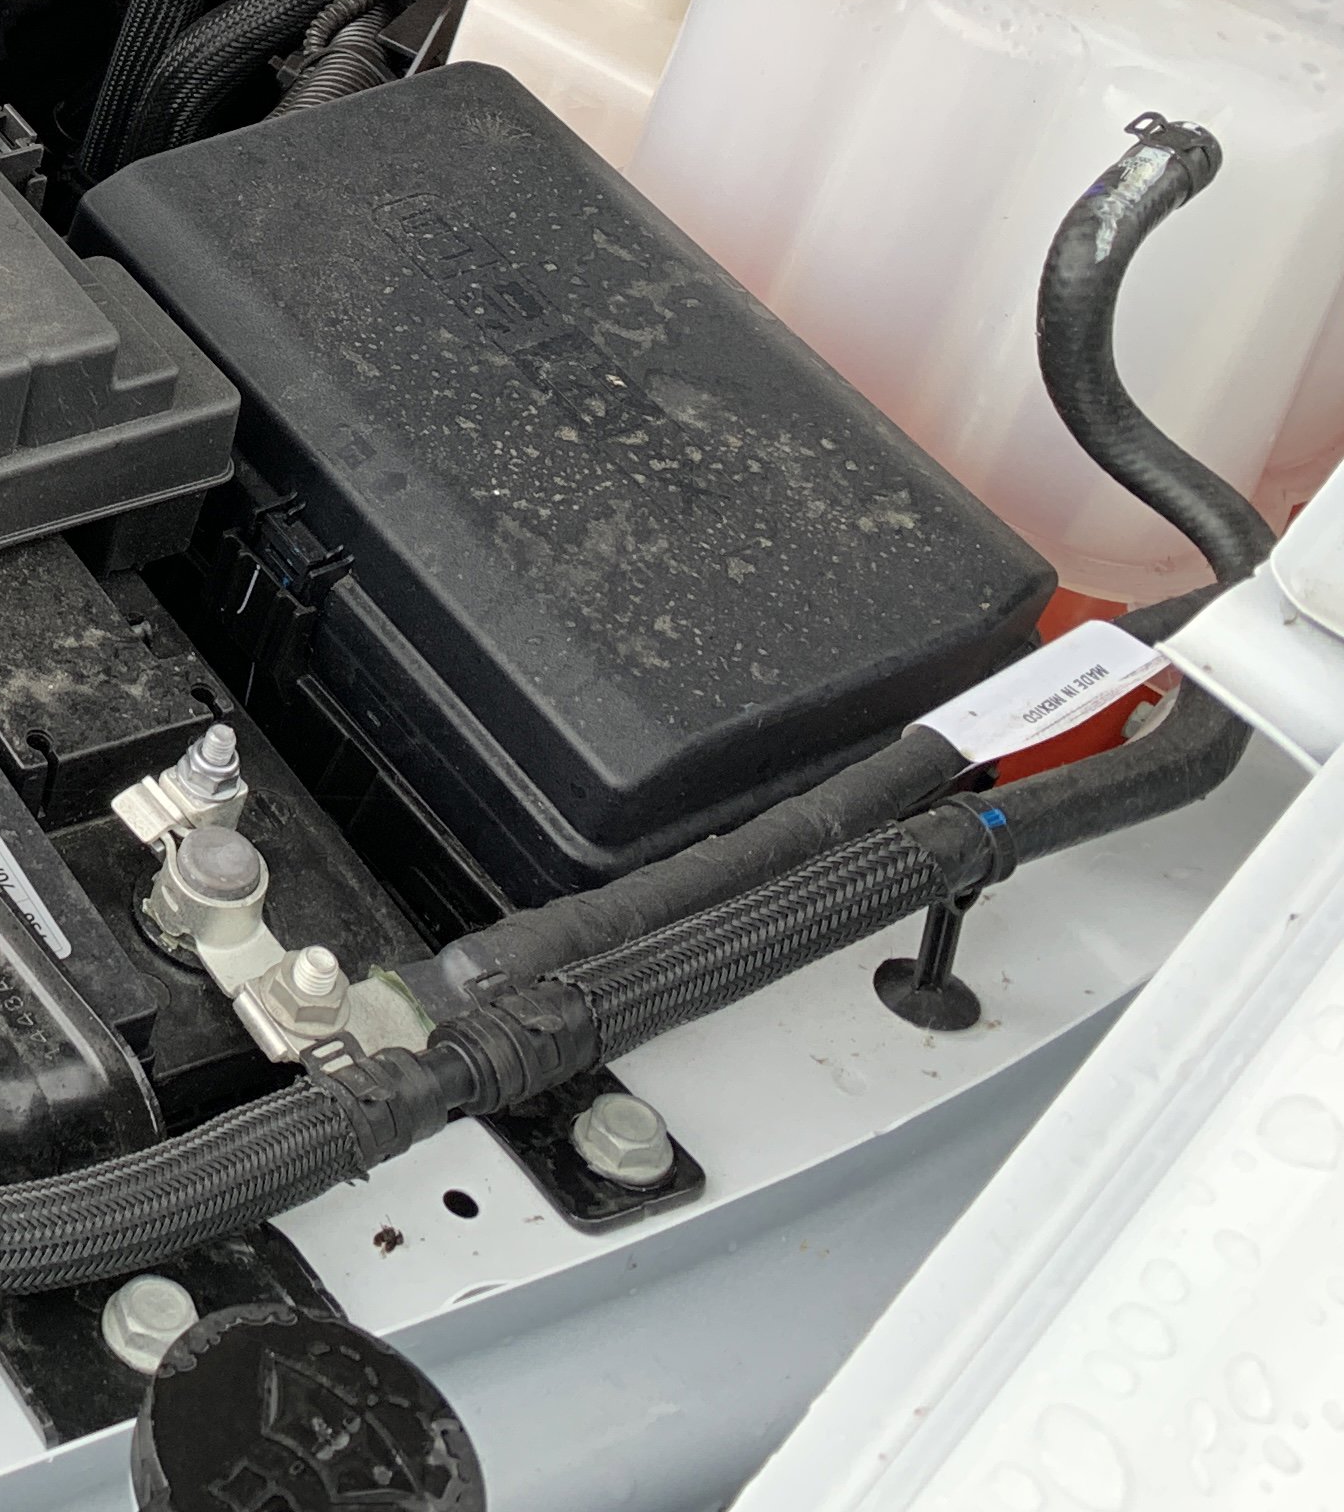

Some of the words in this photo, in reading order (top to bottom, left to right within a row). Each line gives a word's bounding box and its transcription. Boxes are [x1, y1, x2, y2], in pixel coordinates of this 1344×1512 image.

[1075, 663, 1111, 691] MADE
[1060, 687, 1080, 700] IN
[1022, 693, 1068, 725] MEXICO
